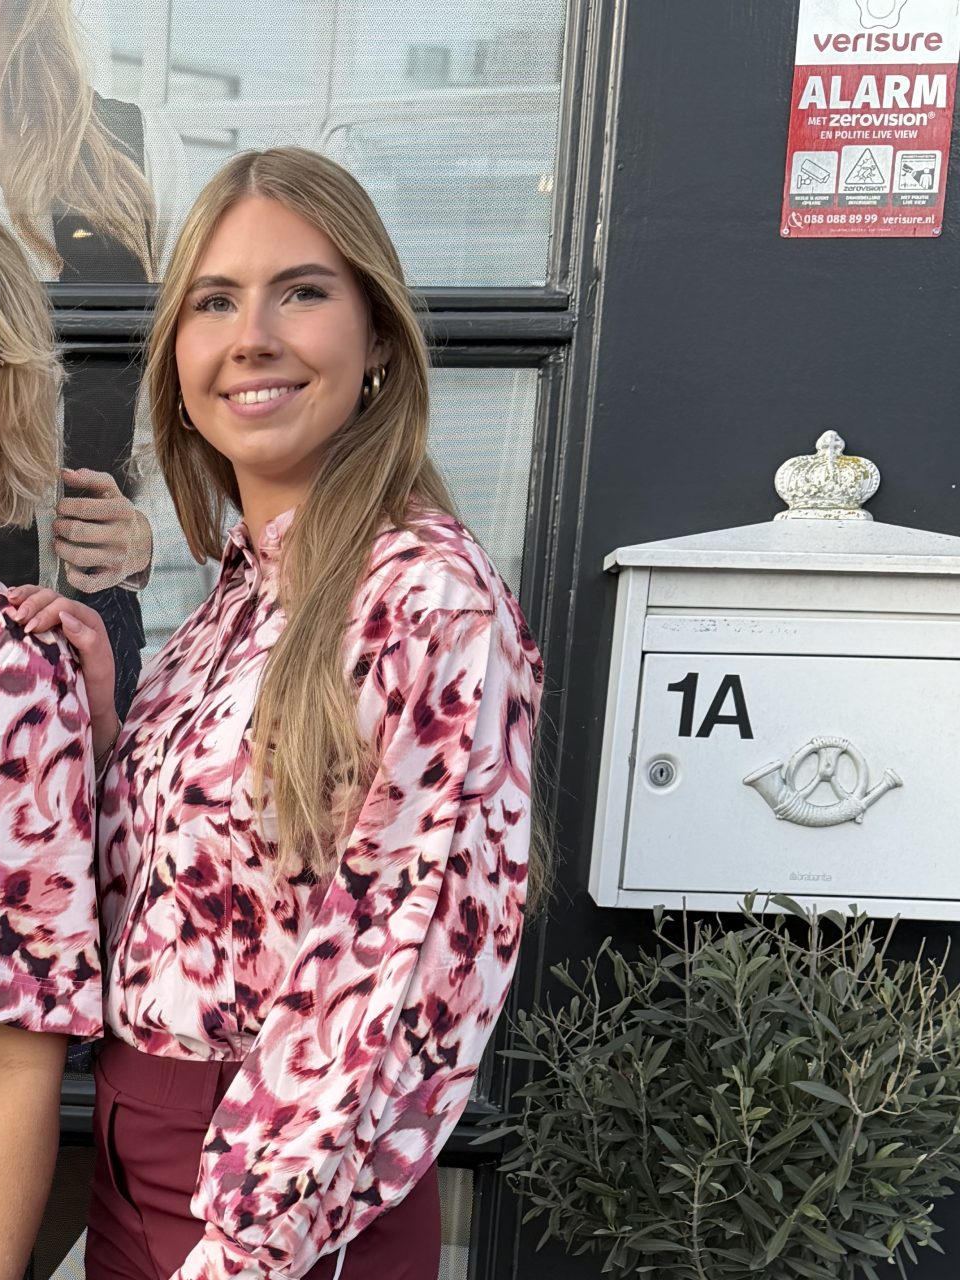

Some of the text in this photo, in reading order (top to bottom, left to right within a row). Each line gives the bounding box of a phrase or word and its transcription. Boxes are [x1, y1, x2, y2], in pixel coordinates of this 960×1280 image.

[813, 32, 943, 52] verisure
[798, 74, 947, 110] ALARM
[808, 117, 827, 126] MET
[820, 130, 918, 140] EN POLITIE LIVE VIEW
[804, 214, 935, 224] 088 088 89 99 verisure.nl
[667, 672, 754, 739] 1A
